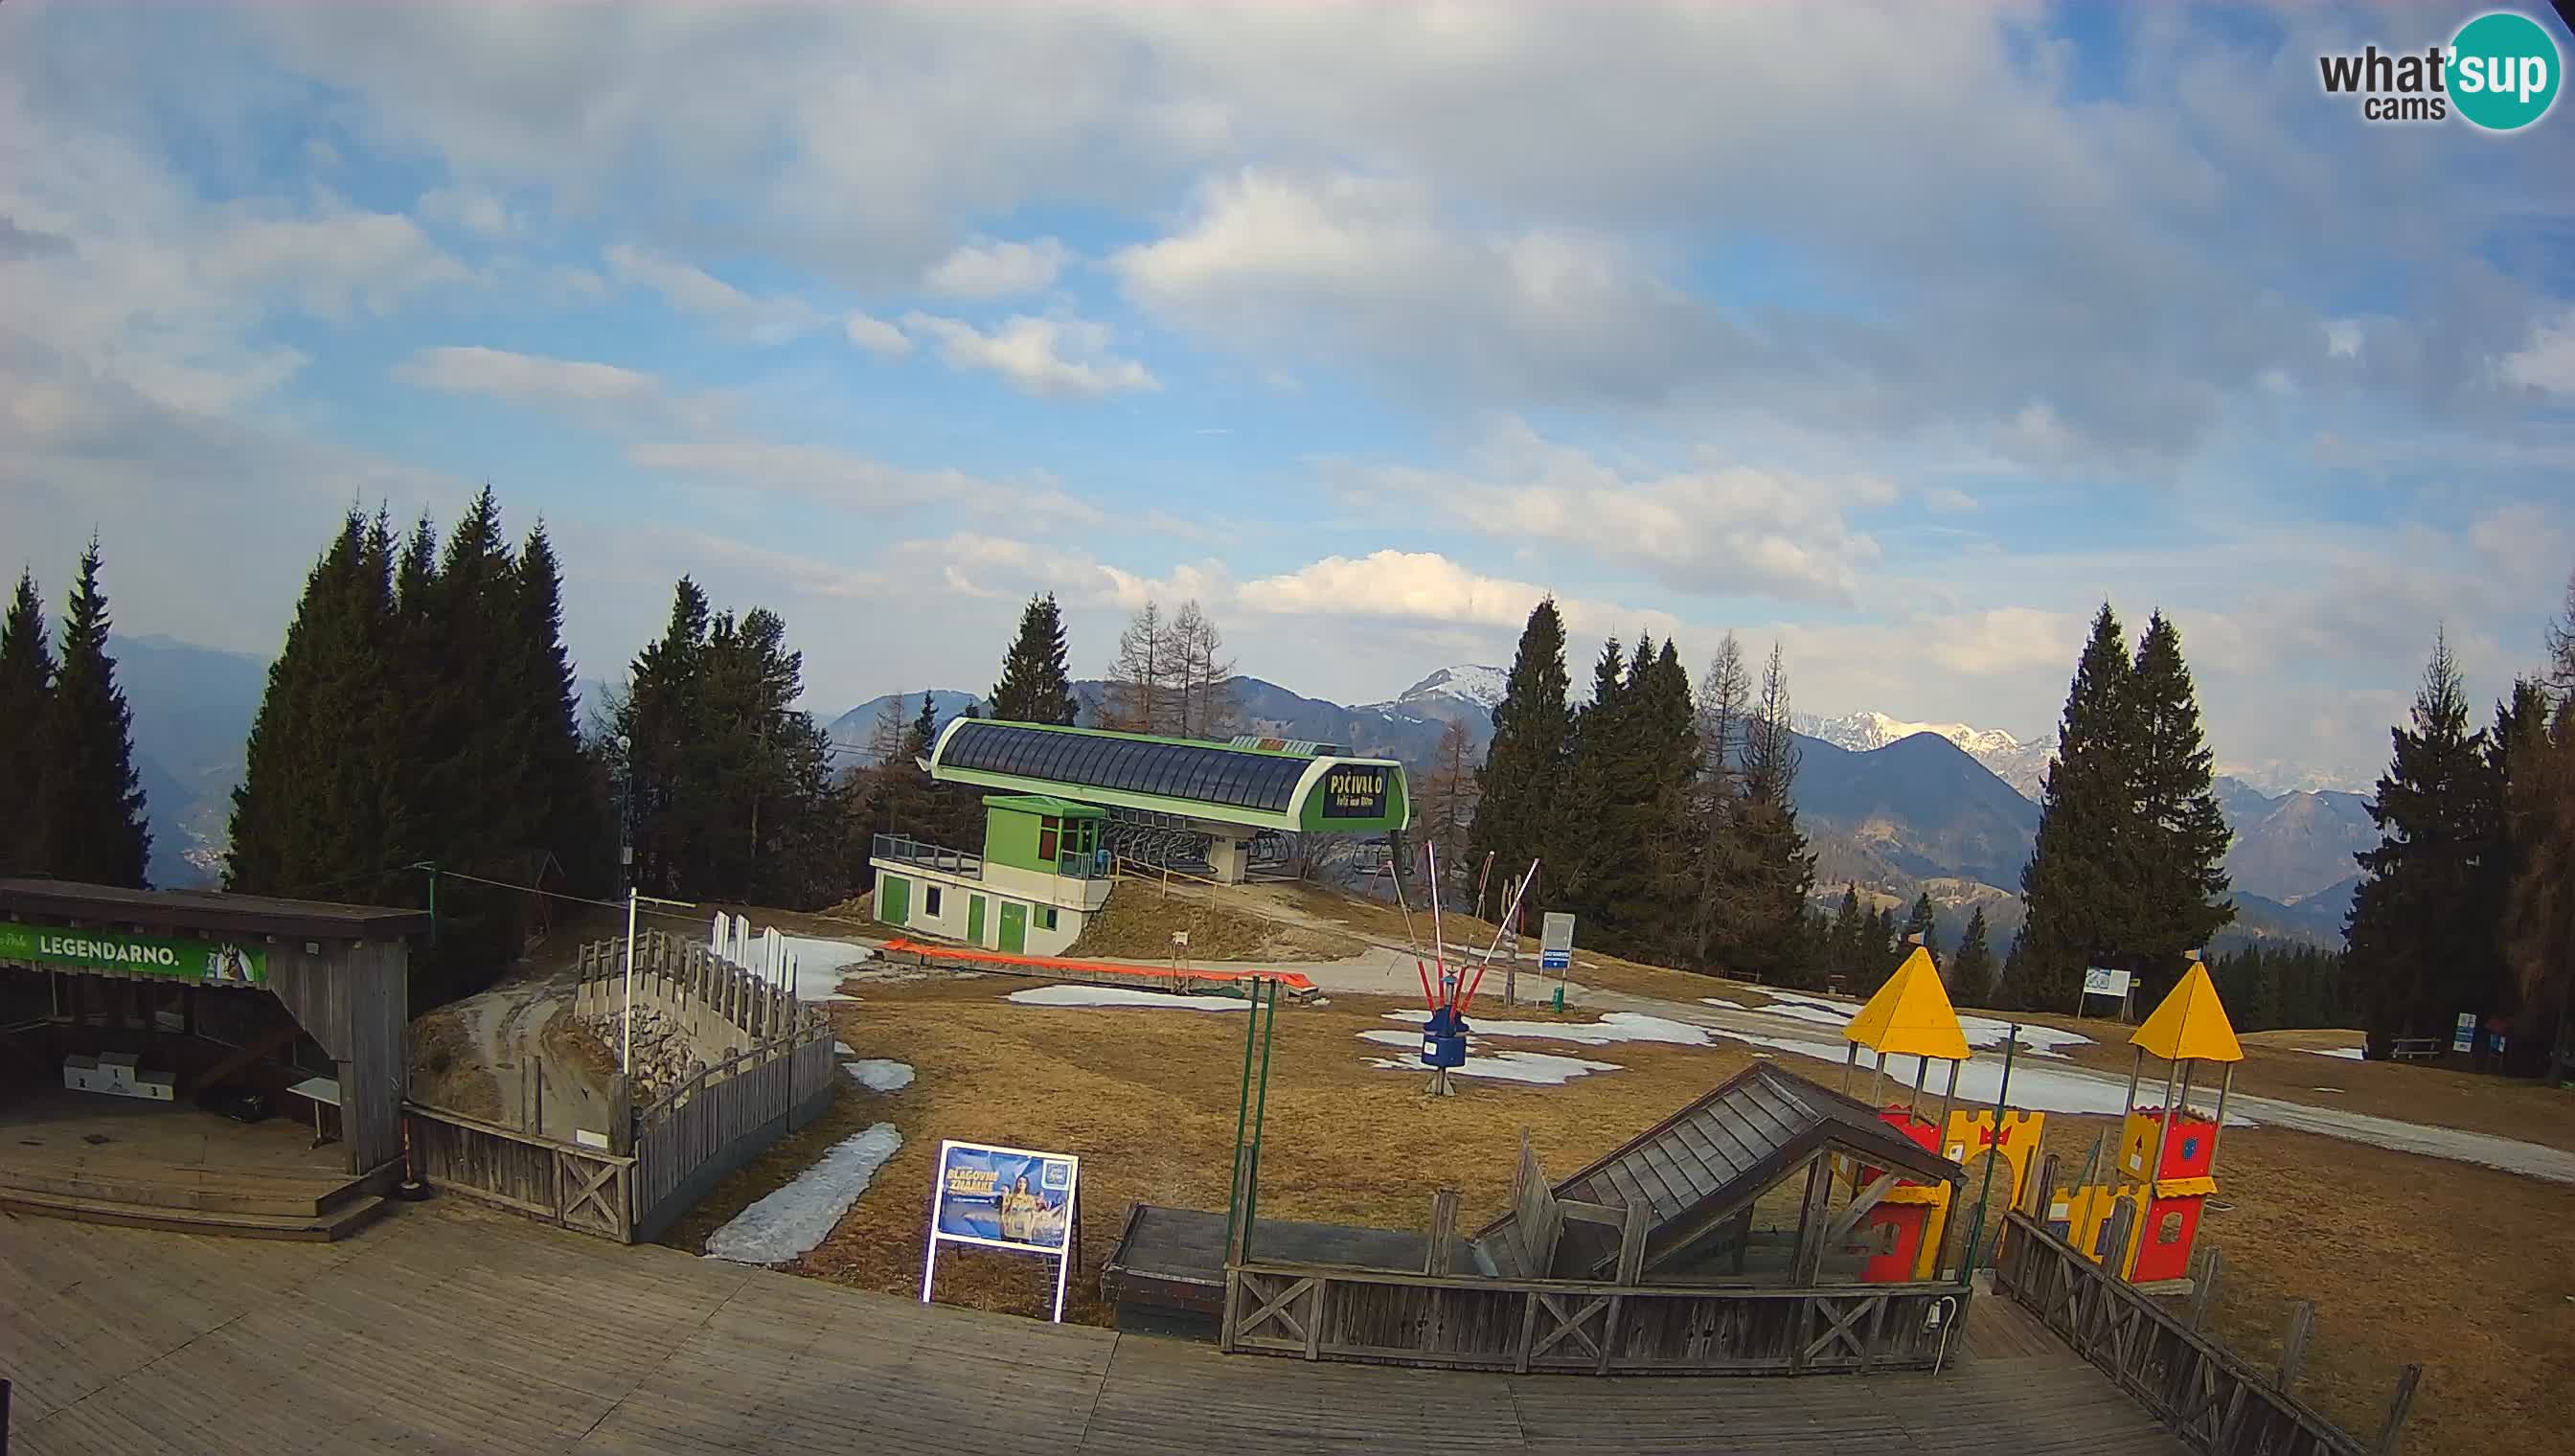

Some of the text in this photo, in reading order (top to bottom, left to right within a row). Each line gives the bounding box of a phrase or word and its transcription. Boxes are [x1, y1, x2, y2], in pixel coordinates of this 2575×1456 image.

[39, 935, 180, 967] LEGENDARNO.
[113, 1068, 119, 1080] 1
[79, 1077, 86, 1089] 2
[150, 1085, 158, 1097] 3
